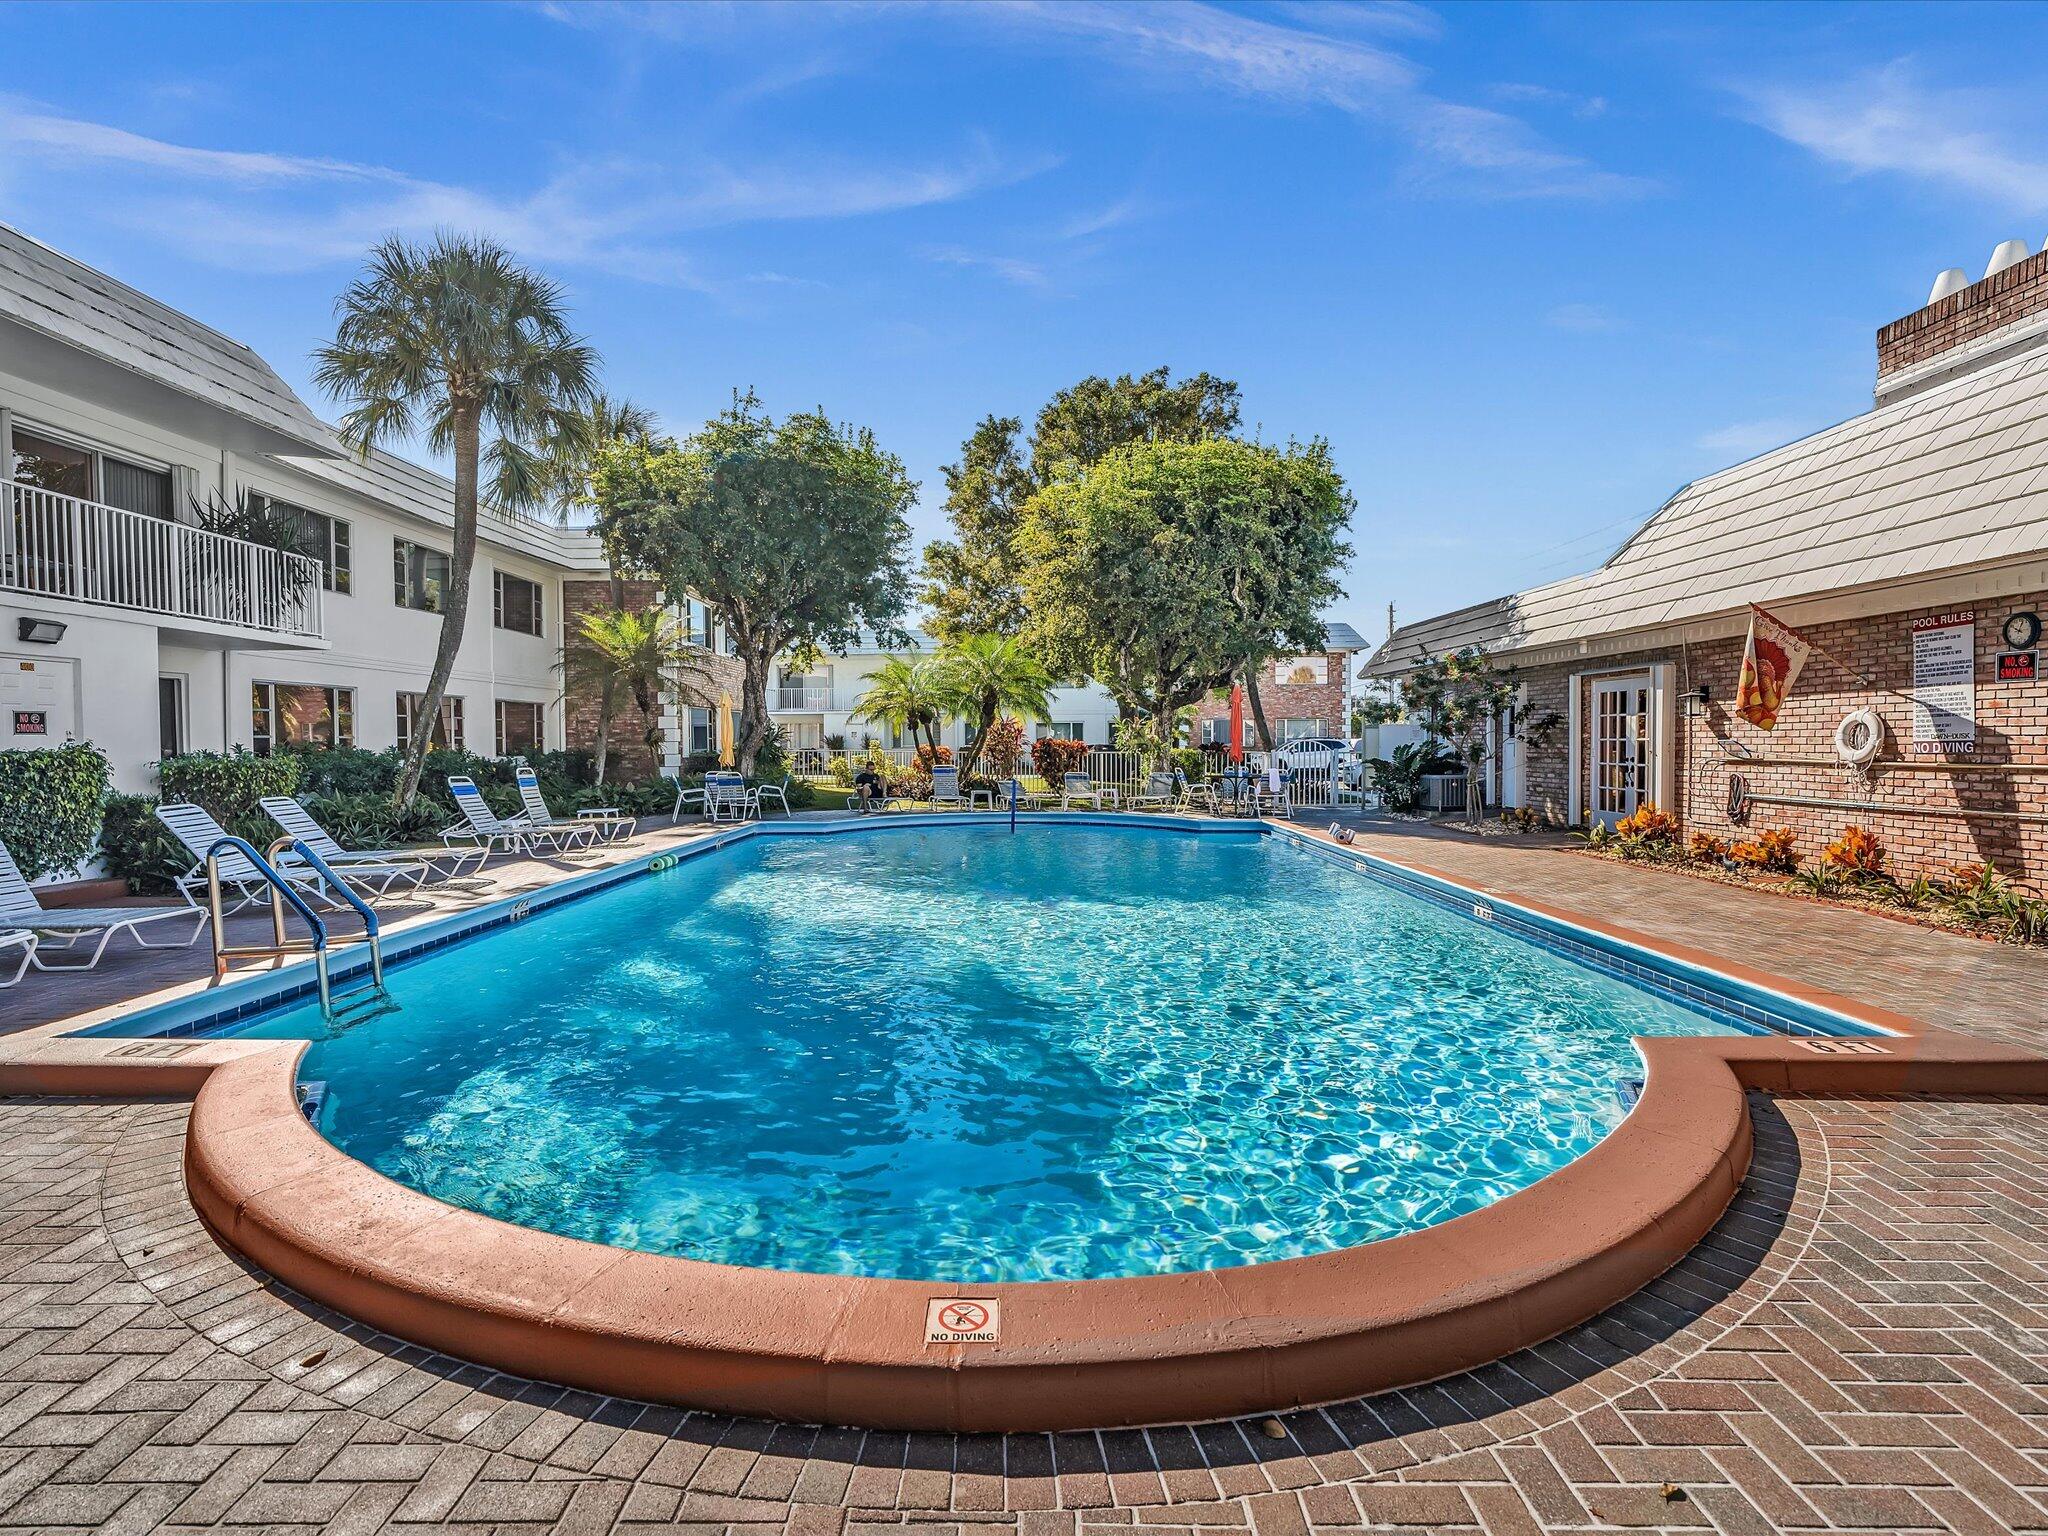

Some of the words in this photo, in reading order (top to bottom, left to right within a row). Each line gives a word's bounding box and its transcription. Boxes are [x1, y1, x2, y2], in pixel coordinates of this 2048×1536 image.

[1913, 617, 1938, 628] POOL
[1940, 611, 1974, 624] RULES
[1754, 616, 1773, 633] Give
[1774, 629, 1803, 653] Thanks
[2000, 667, 2034, 679] SMOKING
[19, 713, 29, 723] NO
[16, 723, 45, 733] SMOKING
[1913, 743, 1930, 753] NO
[1932, 742, 1974, 753] DIVING
[1806, 1041, 1837, 1053] 6
[1833, 1041, 1883, 1053] FT
[931, 1333, 948, 1341] NO
[952, 1332, 995, 1341] DIVING
